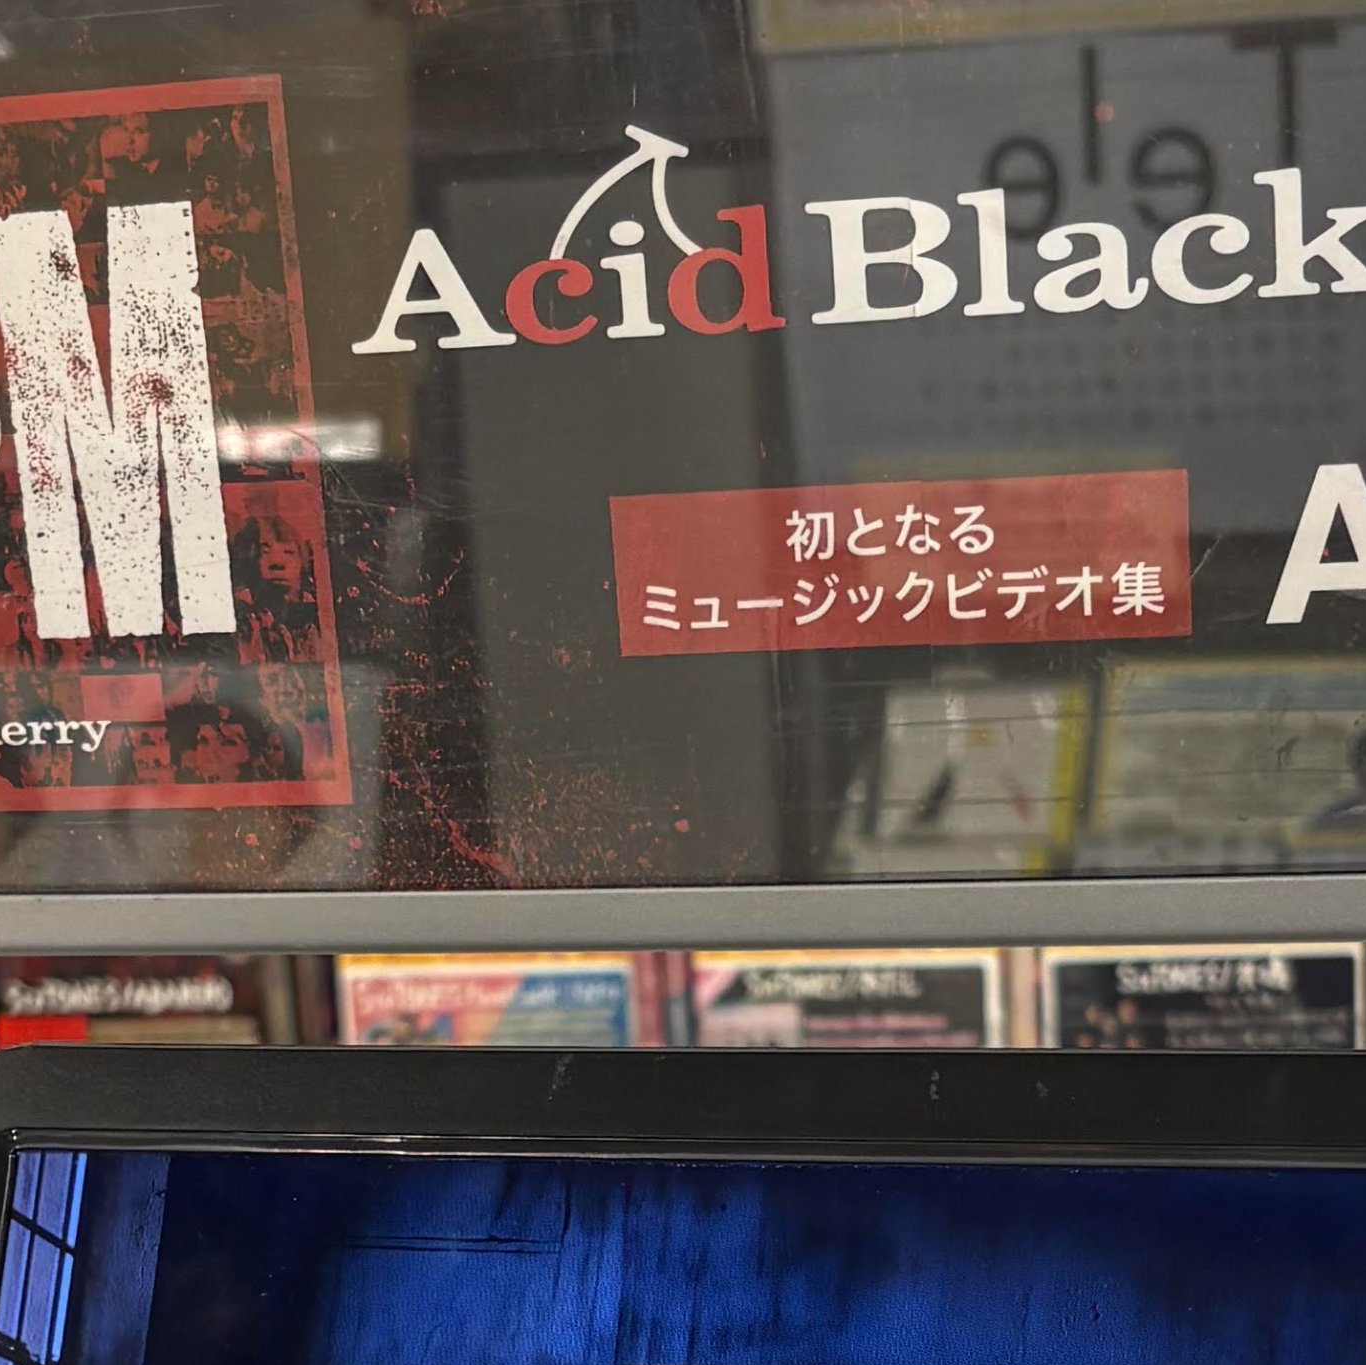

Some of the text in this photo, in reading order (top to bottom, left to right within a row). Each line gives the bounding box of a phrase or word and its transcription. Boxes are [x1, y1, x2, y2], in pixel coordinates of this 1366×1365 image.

[351, 126, 785, 356] Acid
[785, 503, 1001, 563] 初となる
[641, 560, 1168, 635] ミュージックビデオ集
